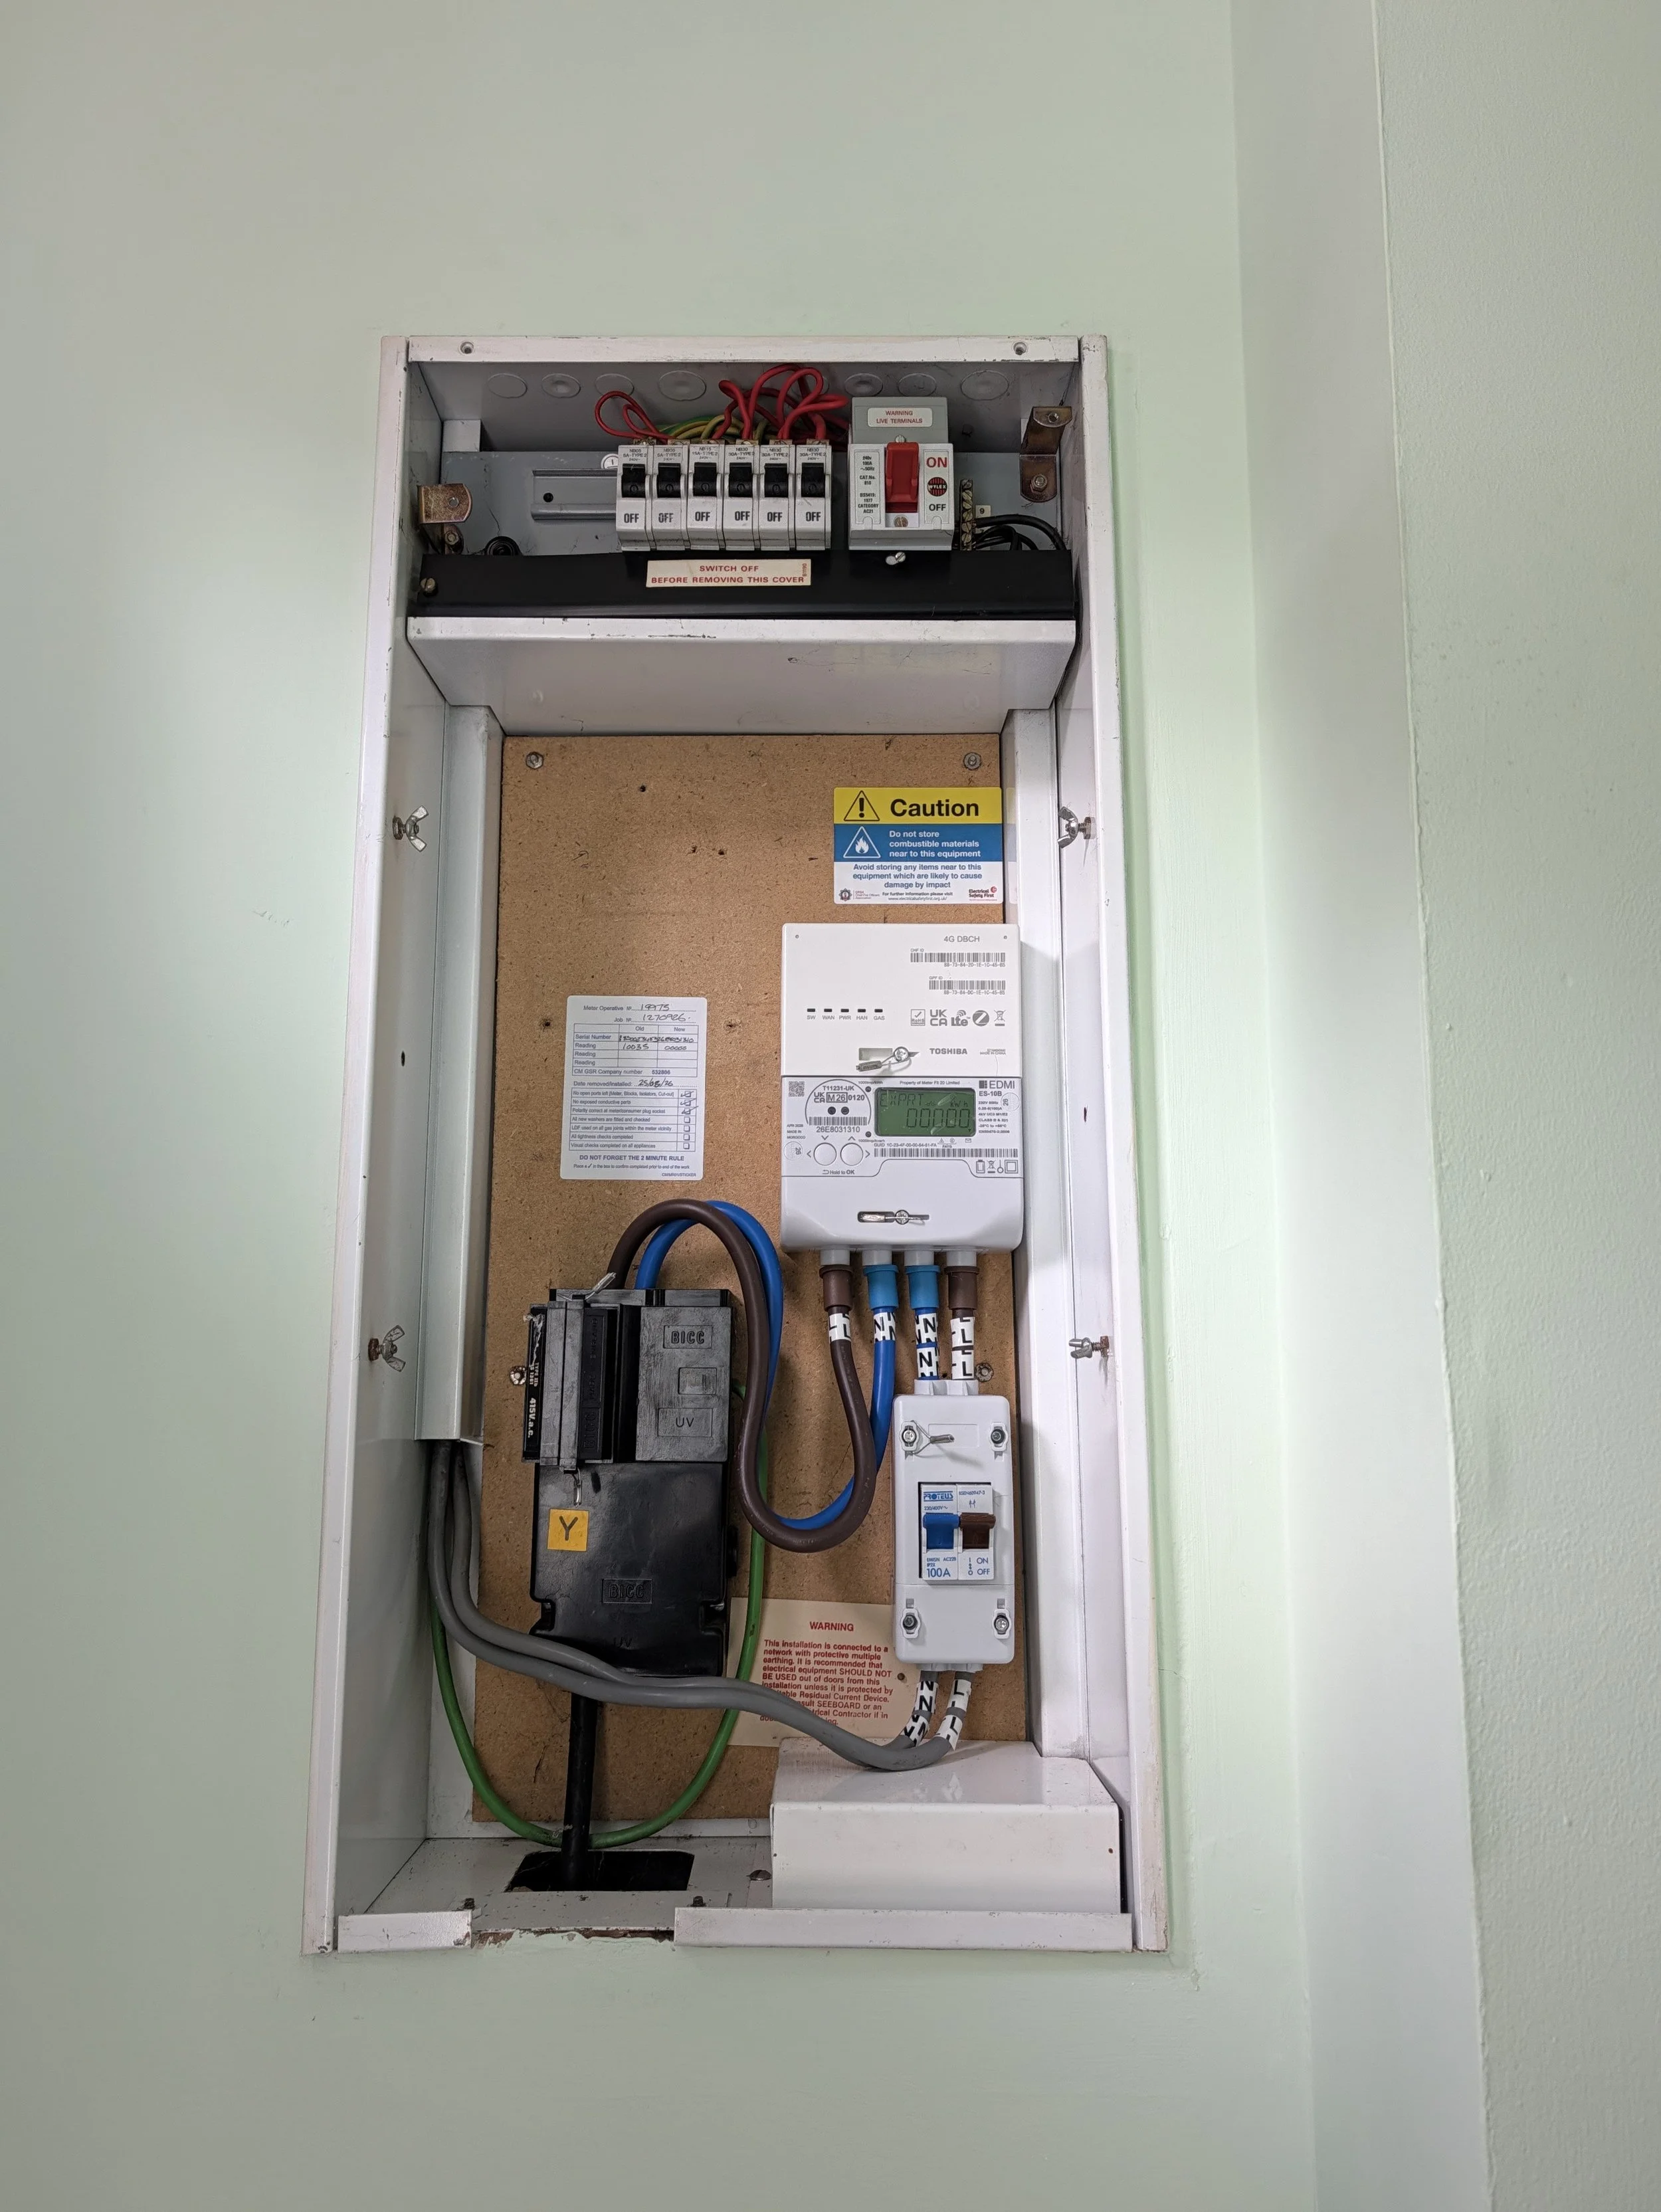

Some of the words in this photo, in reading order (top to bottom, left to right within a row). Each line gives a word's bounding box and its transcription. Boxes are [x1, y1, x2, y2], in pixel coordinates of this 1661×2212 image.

[926, 456, 947, 468] ON
[624, 513, 639, 524] OFF
[658, 512, 674, 523] OFF
[695, 511, 710, 522] OFF
[734, 511, 750, 521] OFF
[767, 512, 783, 522] OFF
[805, 511, 821, 522] OFF
[890, 799, 979, 817] Caution
[937, 851, 981, 859] equipment
[989, 1080, 1015, 1089] EDMI
[906, 1108, 971, 1128] 00000
[671, 1331, 705, 1344] BICC
[961, 1328, 973, 1344] L
[919, 1351, 933, 1368] N
[962, 1361, 973, 1377] L
[676, 1417, 694, 1427] UV
[559, 1516, 579, 1542] Y
[926, 1568, 951, 1578] 100A
[609, 1584, 644, 1599] BICC
[809, 1621, 854, 1631] WARNING
[782, 1640, 822, 1649] installation
[833, 1643, 872, 1652] connected
[813, 1651, 849, 1659] protective
[852, 1652, 881, 1661] multiple
[763, 1657, 795, 1666] earthing.
[814, 1659, 866, 1668] recommended
[798, 1666, 837, 1676] equipment
[839, 1668, 872, 1677] SHOULD
[823, 1676, 844, 1684] doors
[847, 1676, 864, 1685] from
[805, 1683, 829, 1692] unless
[846, 1686, 882, 1694] protected
[884, 1686, 894, 1695] by
[953, 1680, 965, 1696] L
[799, 1690, 830, 1700] Residual
[833, 1693, 861, 1702] Current
[863, 1694, 890, 1703] Device.
[817, 1700, 861, 1710] SEEBOARD
[919, 1695, 933, 1712] N
[832, 1709, 872, 1719] Contractor
